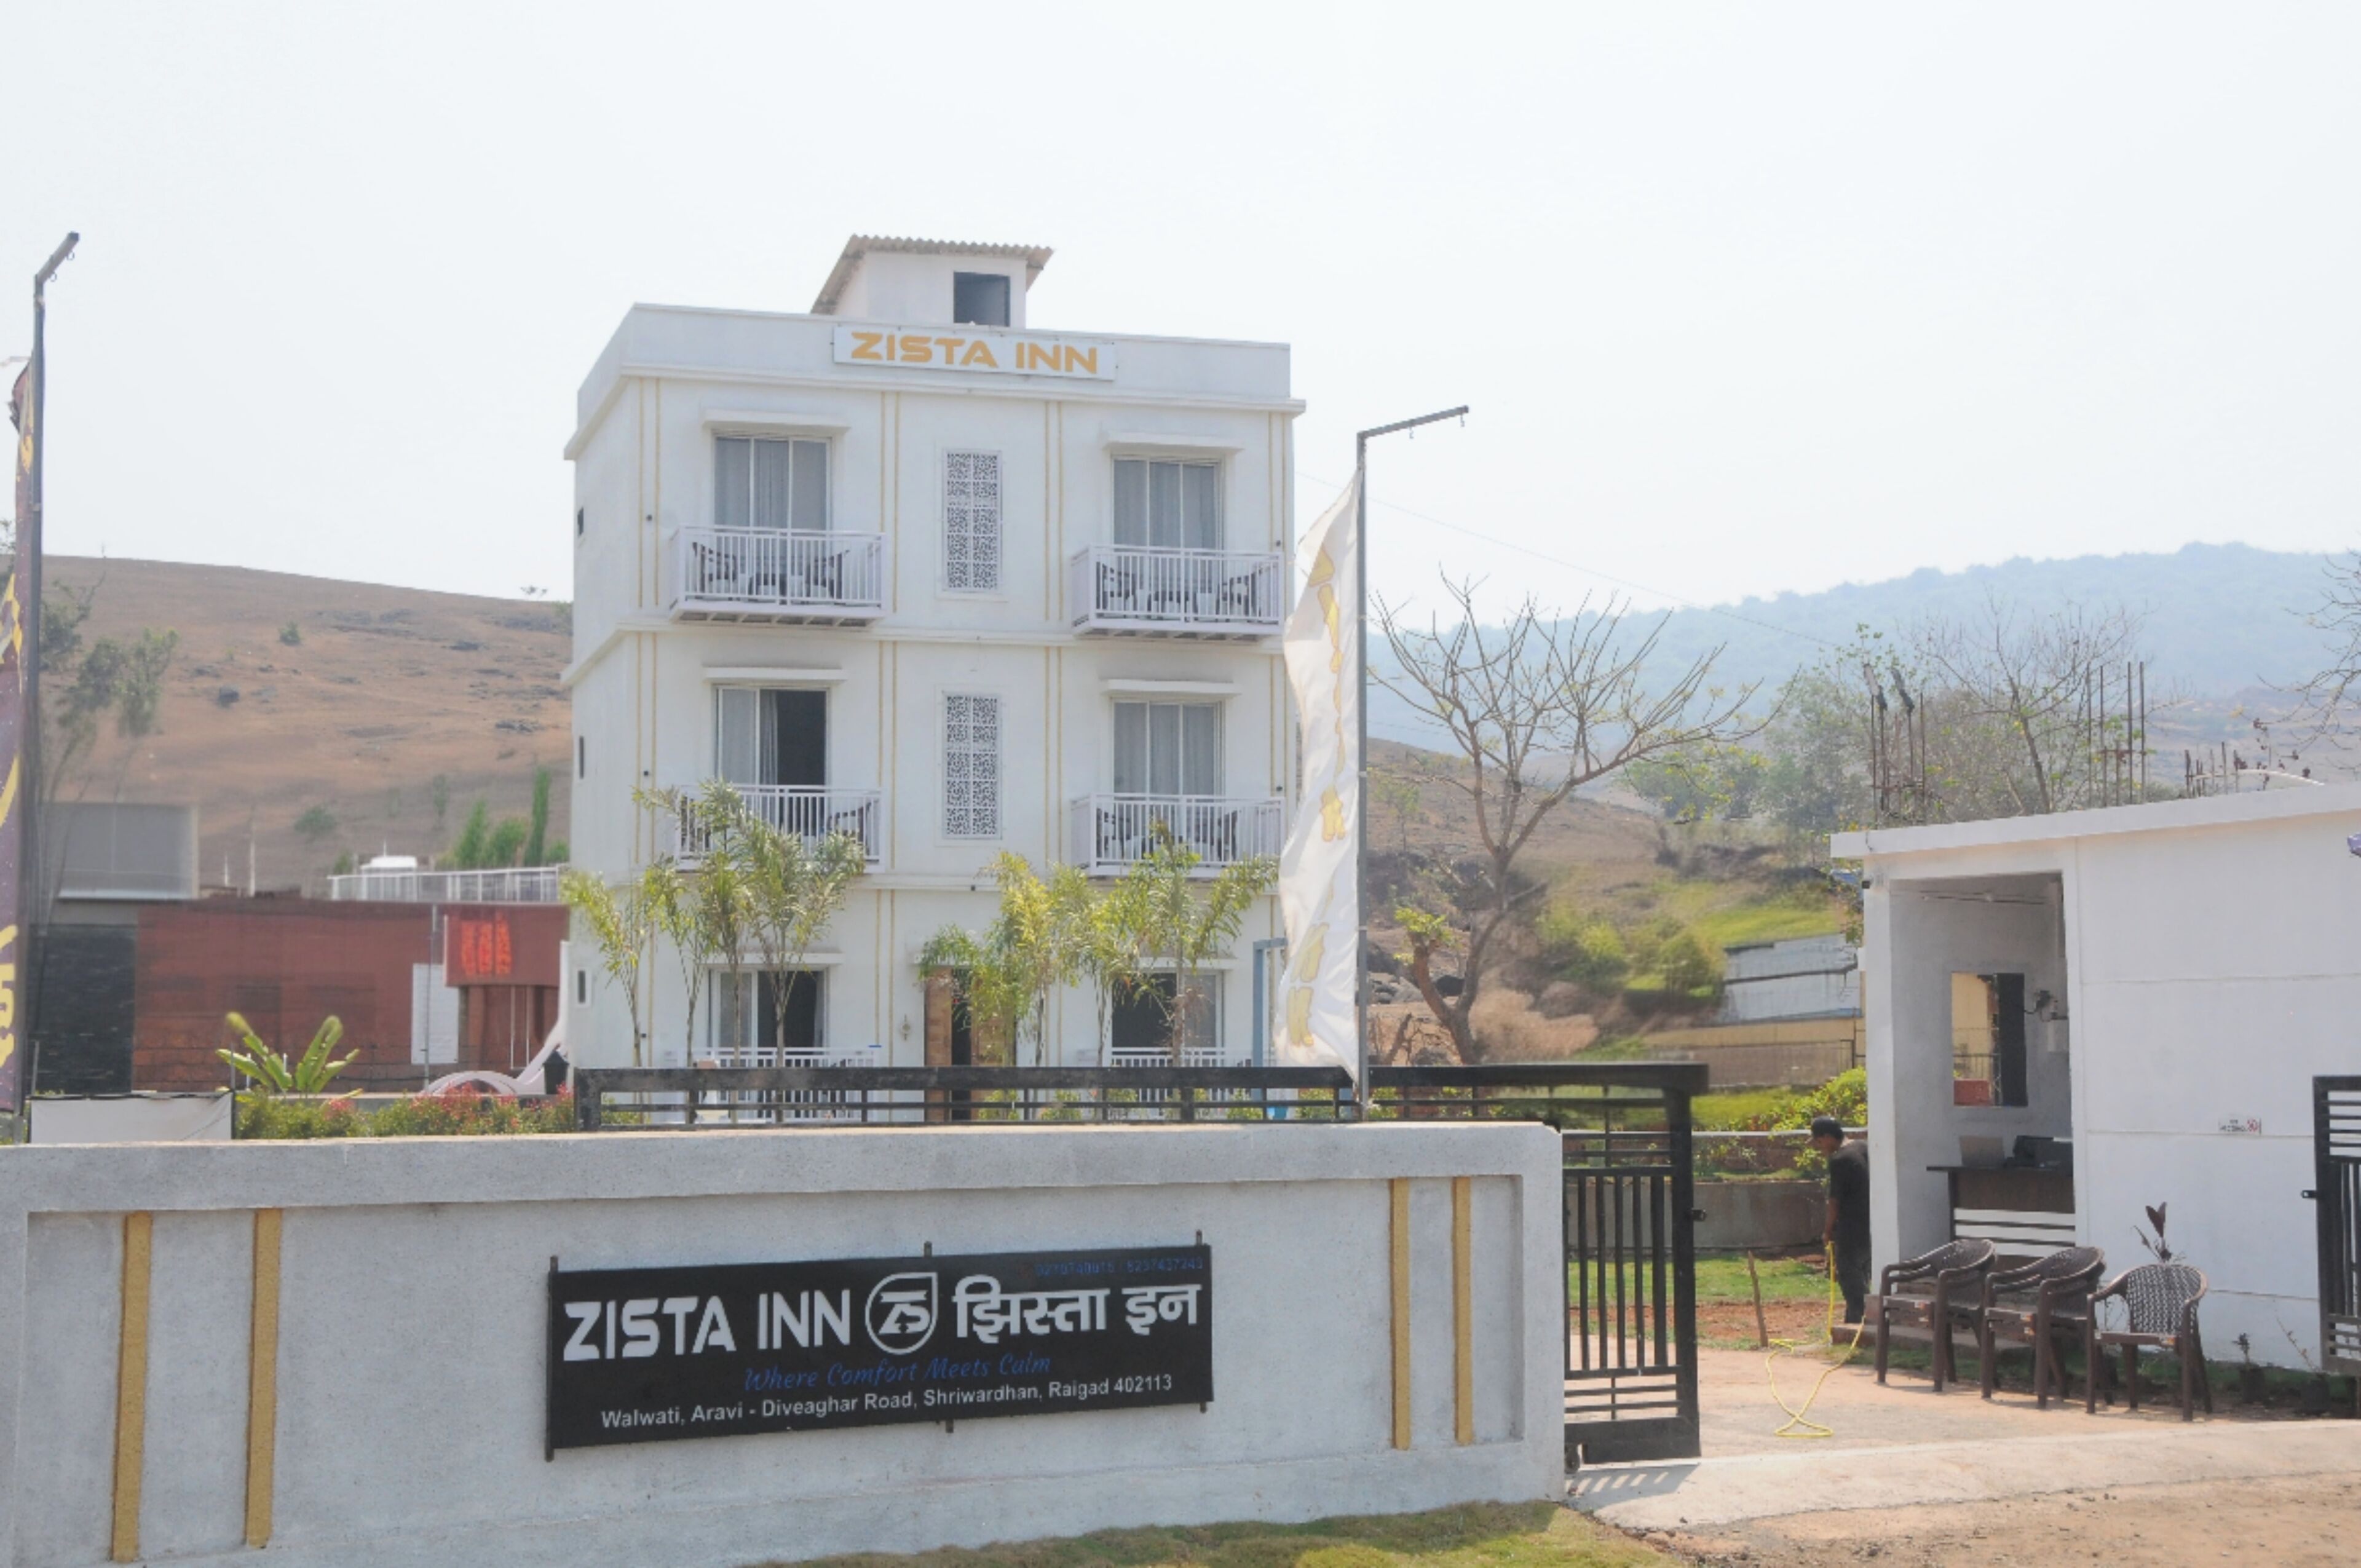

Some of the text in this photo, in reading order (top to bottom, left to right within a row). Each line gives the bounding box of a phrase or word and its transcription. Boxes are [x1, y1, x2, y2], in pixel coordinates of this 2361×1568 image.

[852, 332, 1097, 374] ZISTA INN
[563, 1289, 851, 1361] ZISTA INN
[952, 1274, 1202, 1344] झिस्ता इन
[744, 1350, 1052, 1391] Where Comfort Meets Calm
[601, 1406, 686, 1428] Walwati,
[690, 1402, 743, 1422] Aravi
[762, 1395, 858, 1418] Diveaghar
[864, 1391, 918, 1410] Road,
[923, 1383, 1043, 1406] Shriwardhan,
[1049, 1378, 1110, 1399] Raigad
[1113, 1374, 1173, 1393] 402113
